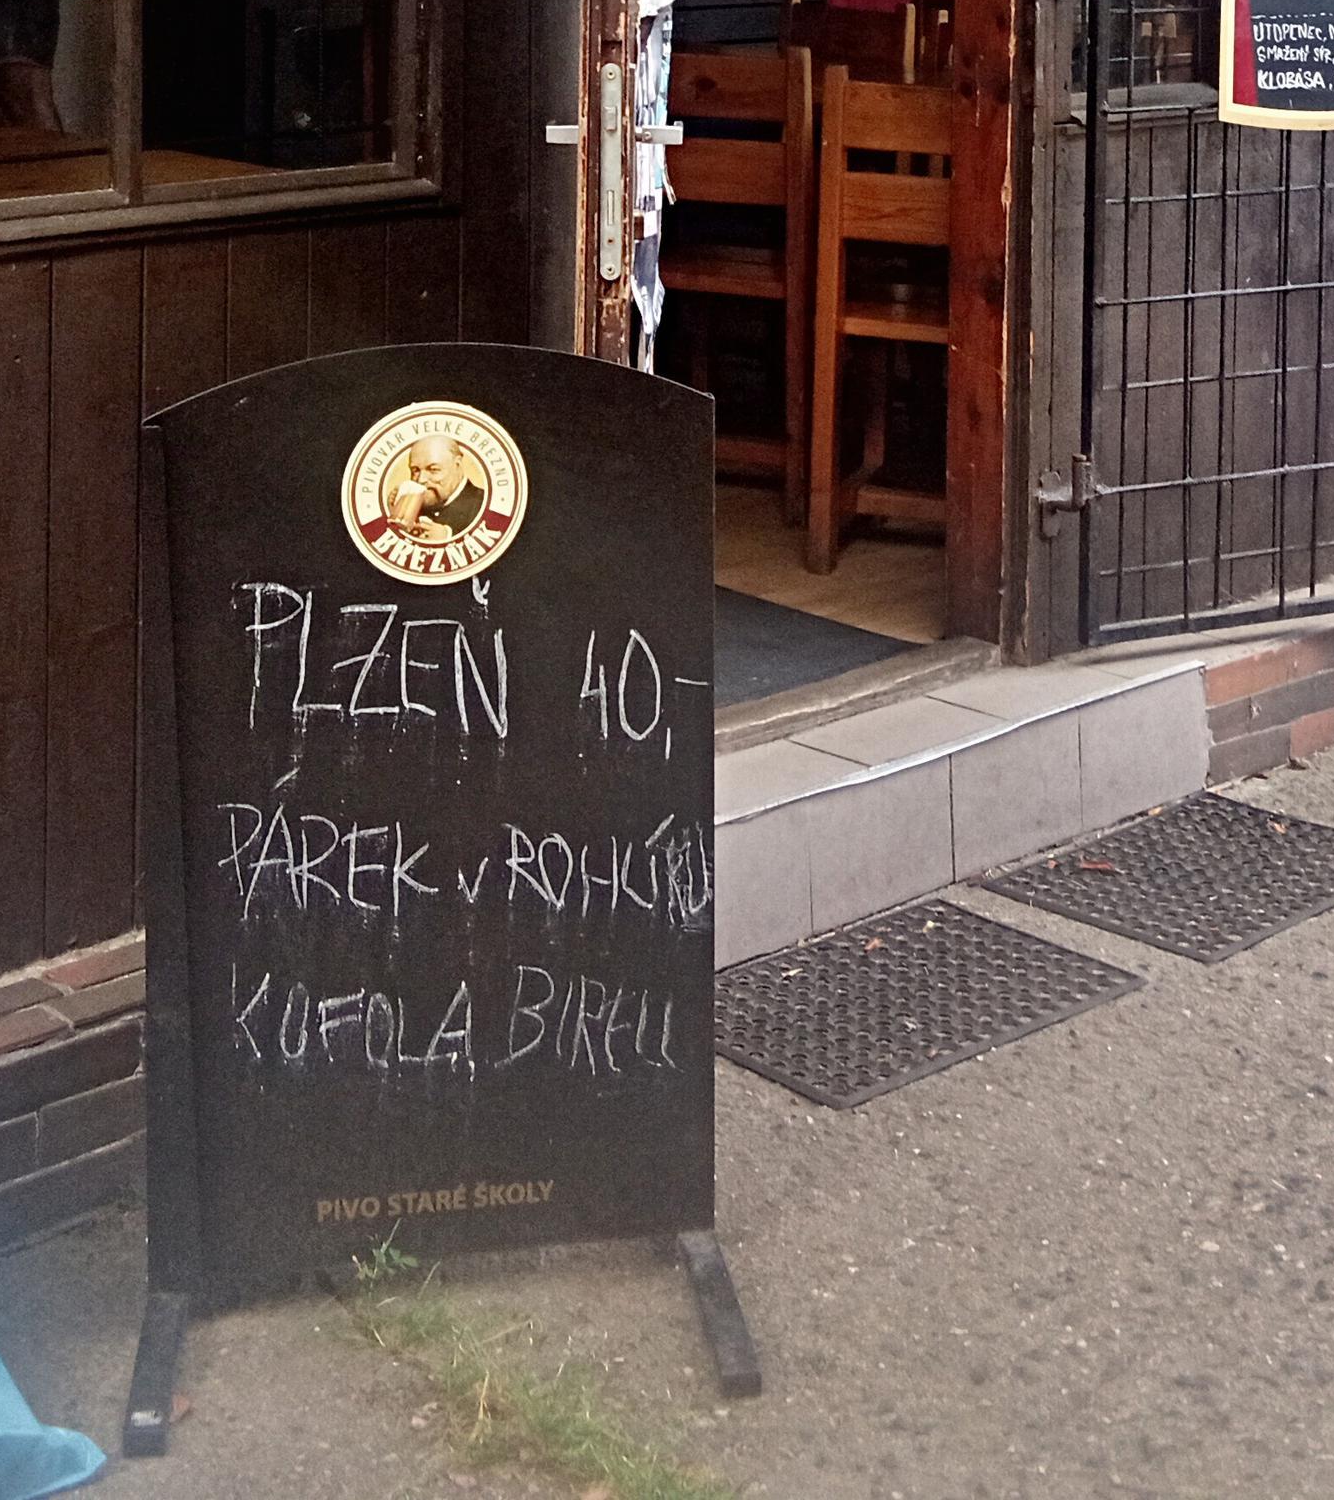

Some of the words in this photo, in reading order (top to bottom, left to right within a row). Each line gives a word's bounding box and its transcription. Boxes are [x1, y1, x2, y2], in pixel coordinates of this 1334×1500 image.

[361, 432, 406, 494] PIVOVAR
[411, 420, 466, 435] VELKÉ
[469, 431, 510, 488] BŘEZNO
[371, 519, 503, 574] BŘEZŇÁK
[239, 574, 509, 740] PLZEŇ
[217, 766, 439, 922] PÁREK
[231, 962, 475, 1078] KOFOLA
[495, 964, 685, 1075] BIRELL
[317, 1197, 381, 1223] PIVO
[387, 1183, 468, 1217] STARÉ
[473, 1179, 555, 1209] ŠKOLY
